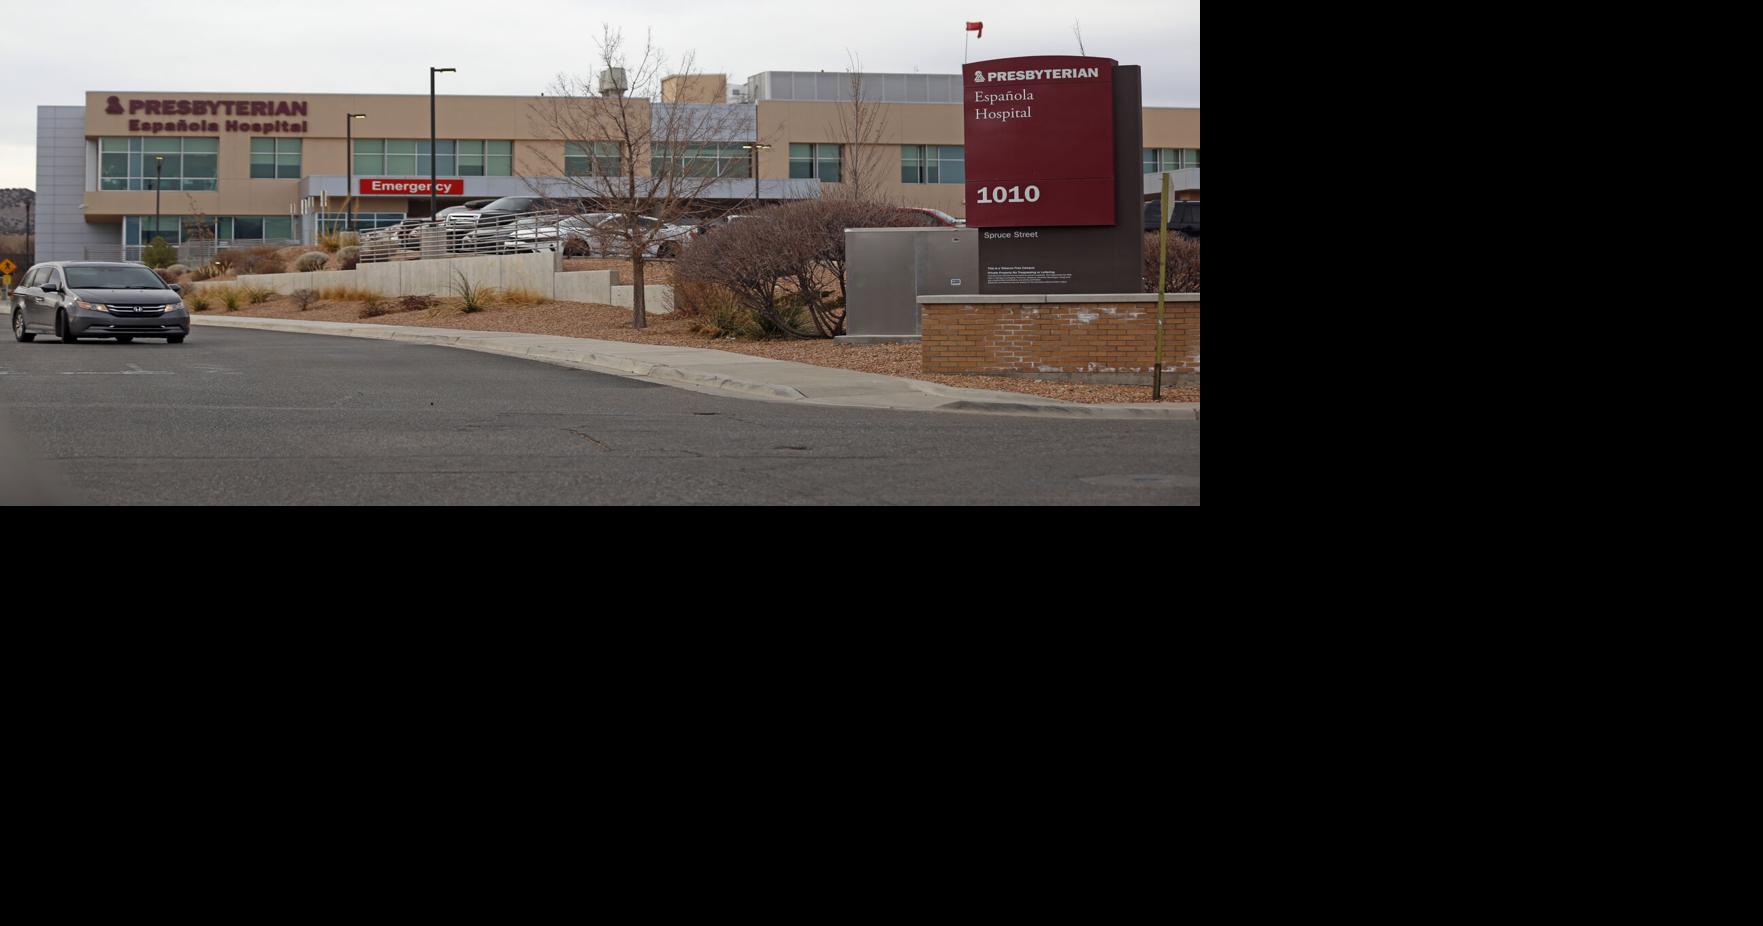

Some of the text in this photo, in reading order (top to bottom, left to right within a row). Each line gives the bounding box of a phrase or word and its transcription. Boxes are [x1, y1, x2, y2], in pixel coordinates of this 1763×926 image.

[987, 68, 1099, 82] PRESBYTERIAN
[975, 89, 1034, 105] Española
[129, 100, 308, 116] PRESBYTERIAN
[975, 107, 1032, 122] Hospital
[129, 119, 308, 134] Española Hospital
[977, 185, 1040, 204] 1010
[984, 231, 1038, 240] Spruce Street
